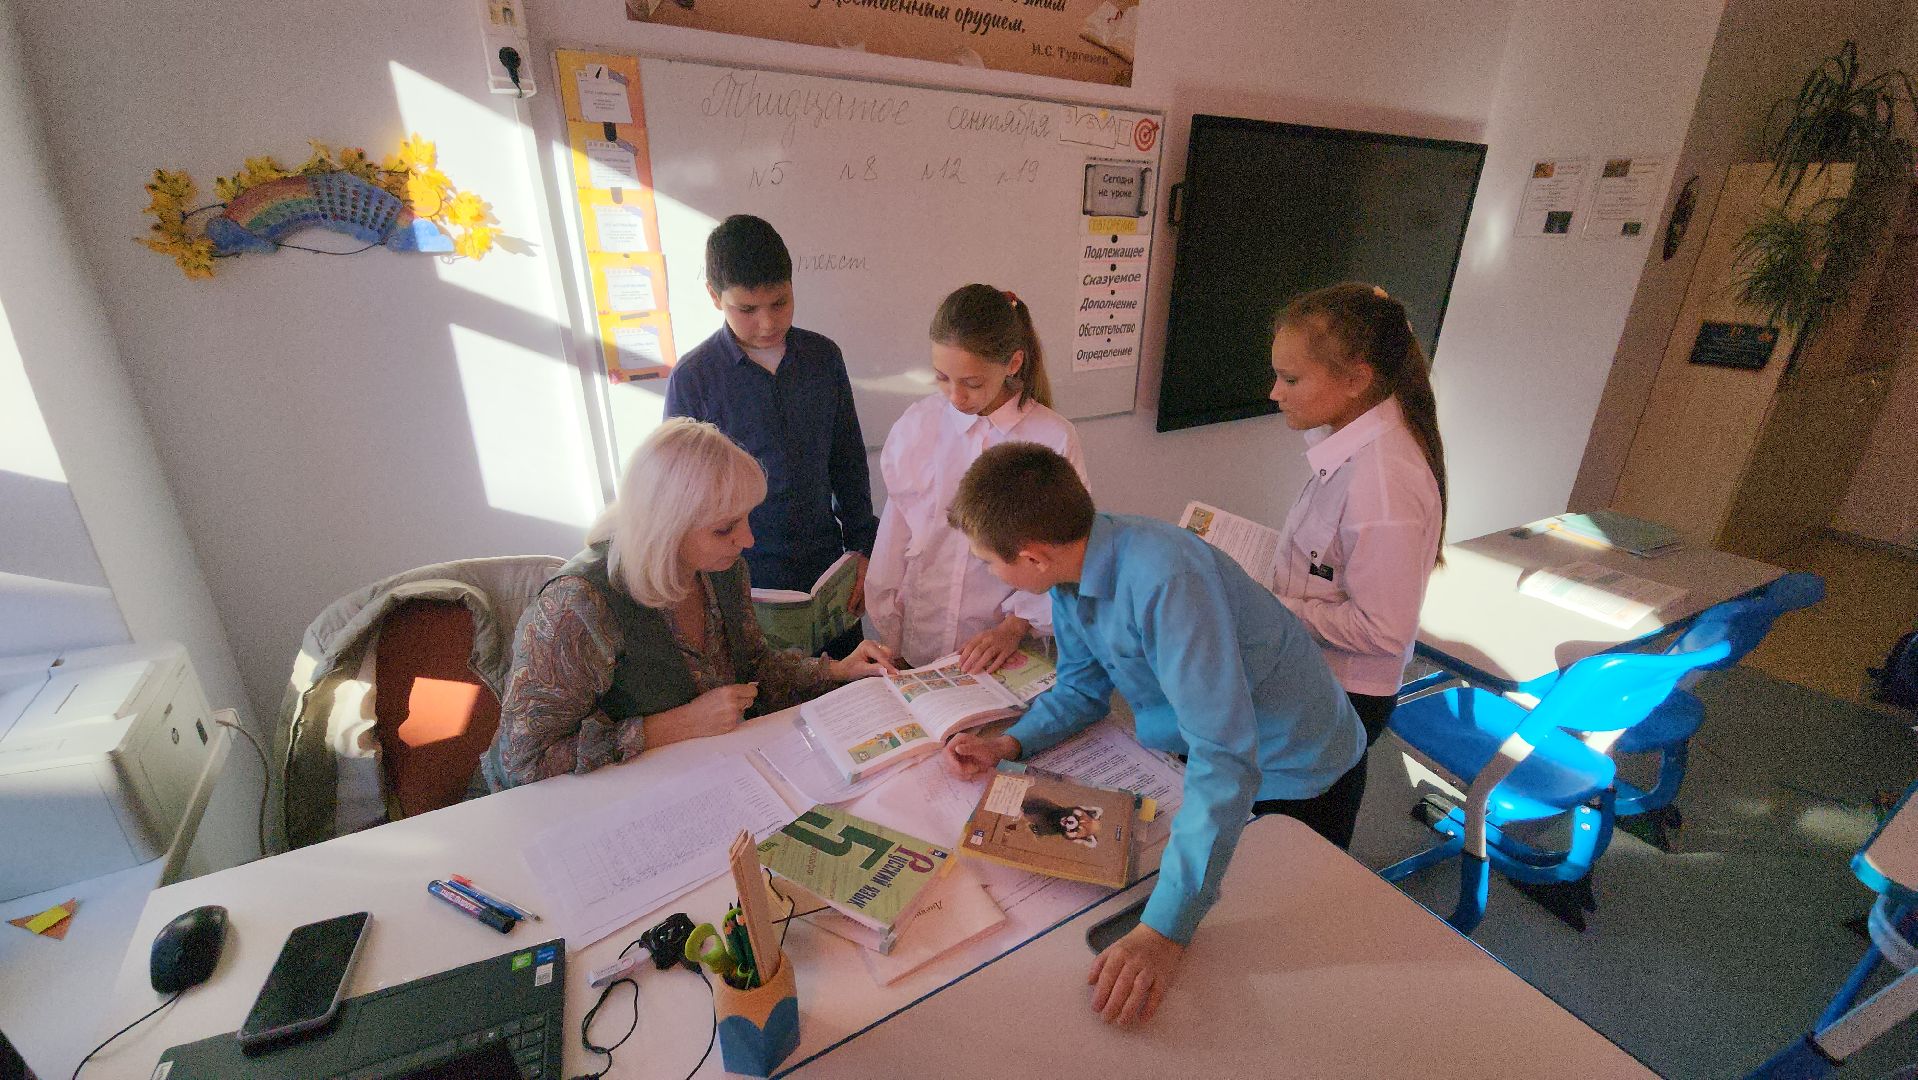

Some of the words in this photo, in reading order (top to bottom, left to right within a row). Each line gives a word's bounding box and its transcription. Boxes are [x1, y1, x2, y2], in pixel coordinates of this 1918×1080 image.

[954, 7, 1026, 35] орудием.
[1102, 173, 1134, 185] Сегодня
[1083, 245, 1145, 261] Подлежащее
[1082, 272, 1142, 288] Сказуемое
[1080, 297, 1138, 311] Дополнение
[1078, 323, 1136, 337] Обстоятельство
[1076, 345, 1133, 362] Определение
[781, 811, 895, 871] 5
